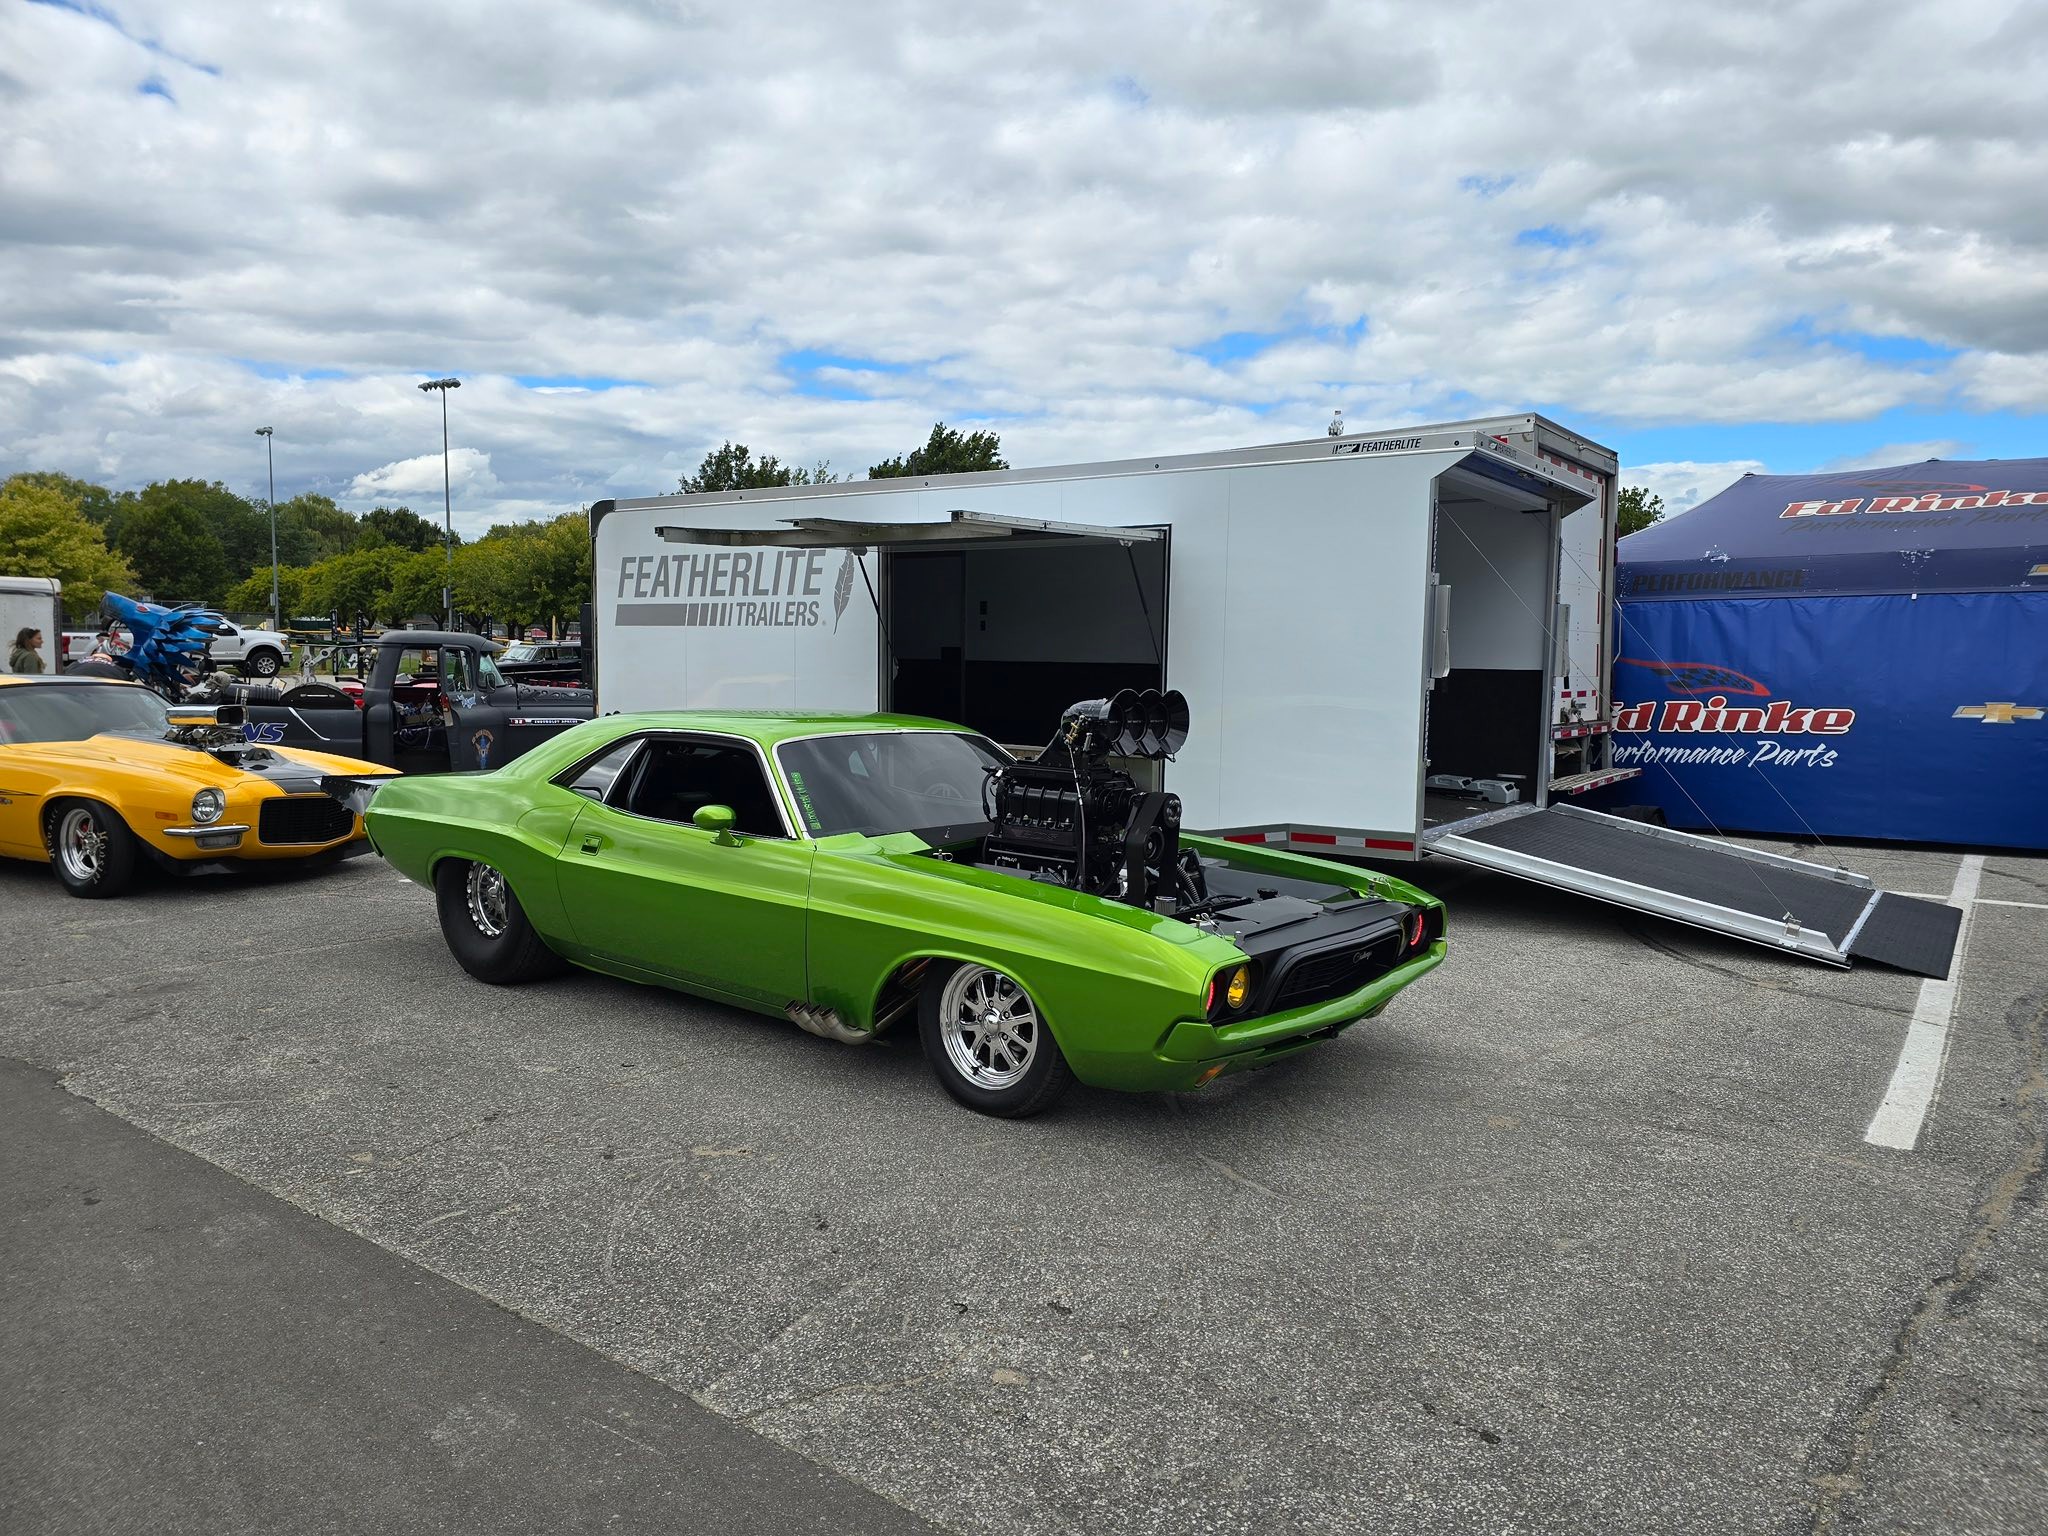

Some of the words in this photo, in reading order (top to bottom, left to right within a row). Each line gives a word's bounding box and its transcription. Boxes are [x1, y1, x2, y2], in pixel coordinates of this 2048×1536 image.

[1360, 437, 1422, 453] FEATHERLITE
[1779, 498, 1864, 518] Ed
[617, 549, 827, 599] FEATHERLITE
[1632, 570, 1805, 592] PERFORMANCE
[736, 601, 820, 627] TRAILERS
[1658, 696, 1856, 735] Rinke
[1748, 740, 1839, 768] Parts
